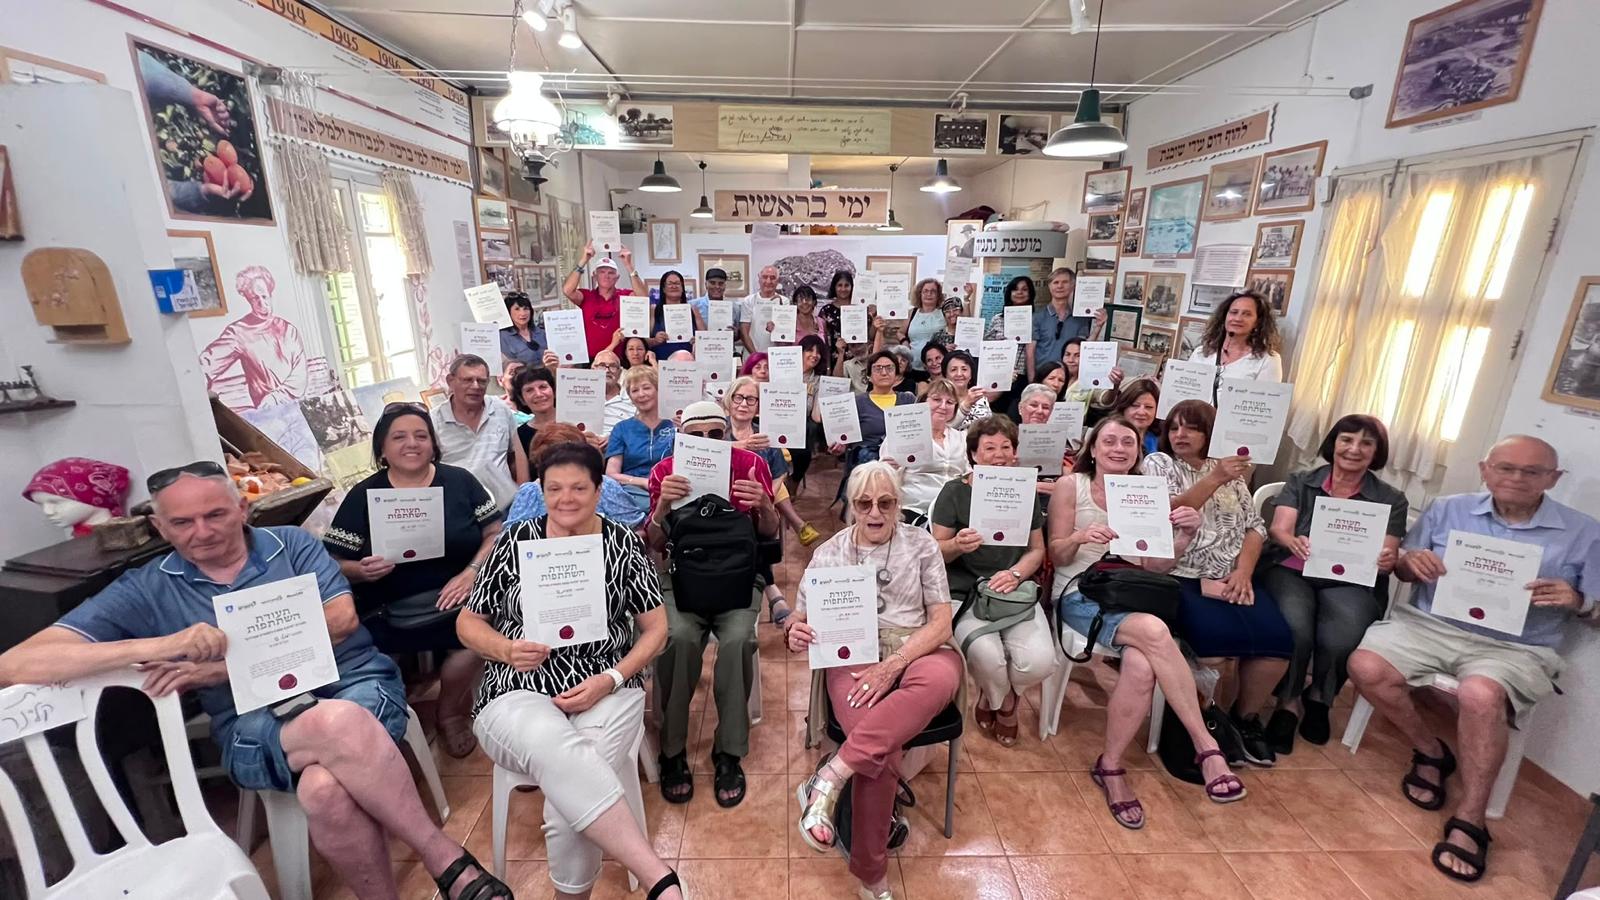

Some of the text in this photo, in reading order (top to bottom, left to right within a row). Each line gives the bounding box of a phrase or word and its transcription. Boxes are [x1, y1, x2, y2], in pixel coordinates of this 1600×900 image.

[272, 0, 306, 24] 1944
[330, 24, 358, 52] 1945
[378, 50, 400, 70] 1946
[448, 88, 464, 106] 1948
[732, 194, 870, 218] ימי בראשית
[1000, 238, 1042, 252] מועצת
[541, 570, 585, 581] השתתפות
[548, 564, 577, 573] תעודת
[247, 613, 301, 633] השתתפות
[256, 608, 290, 623] תעודת
